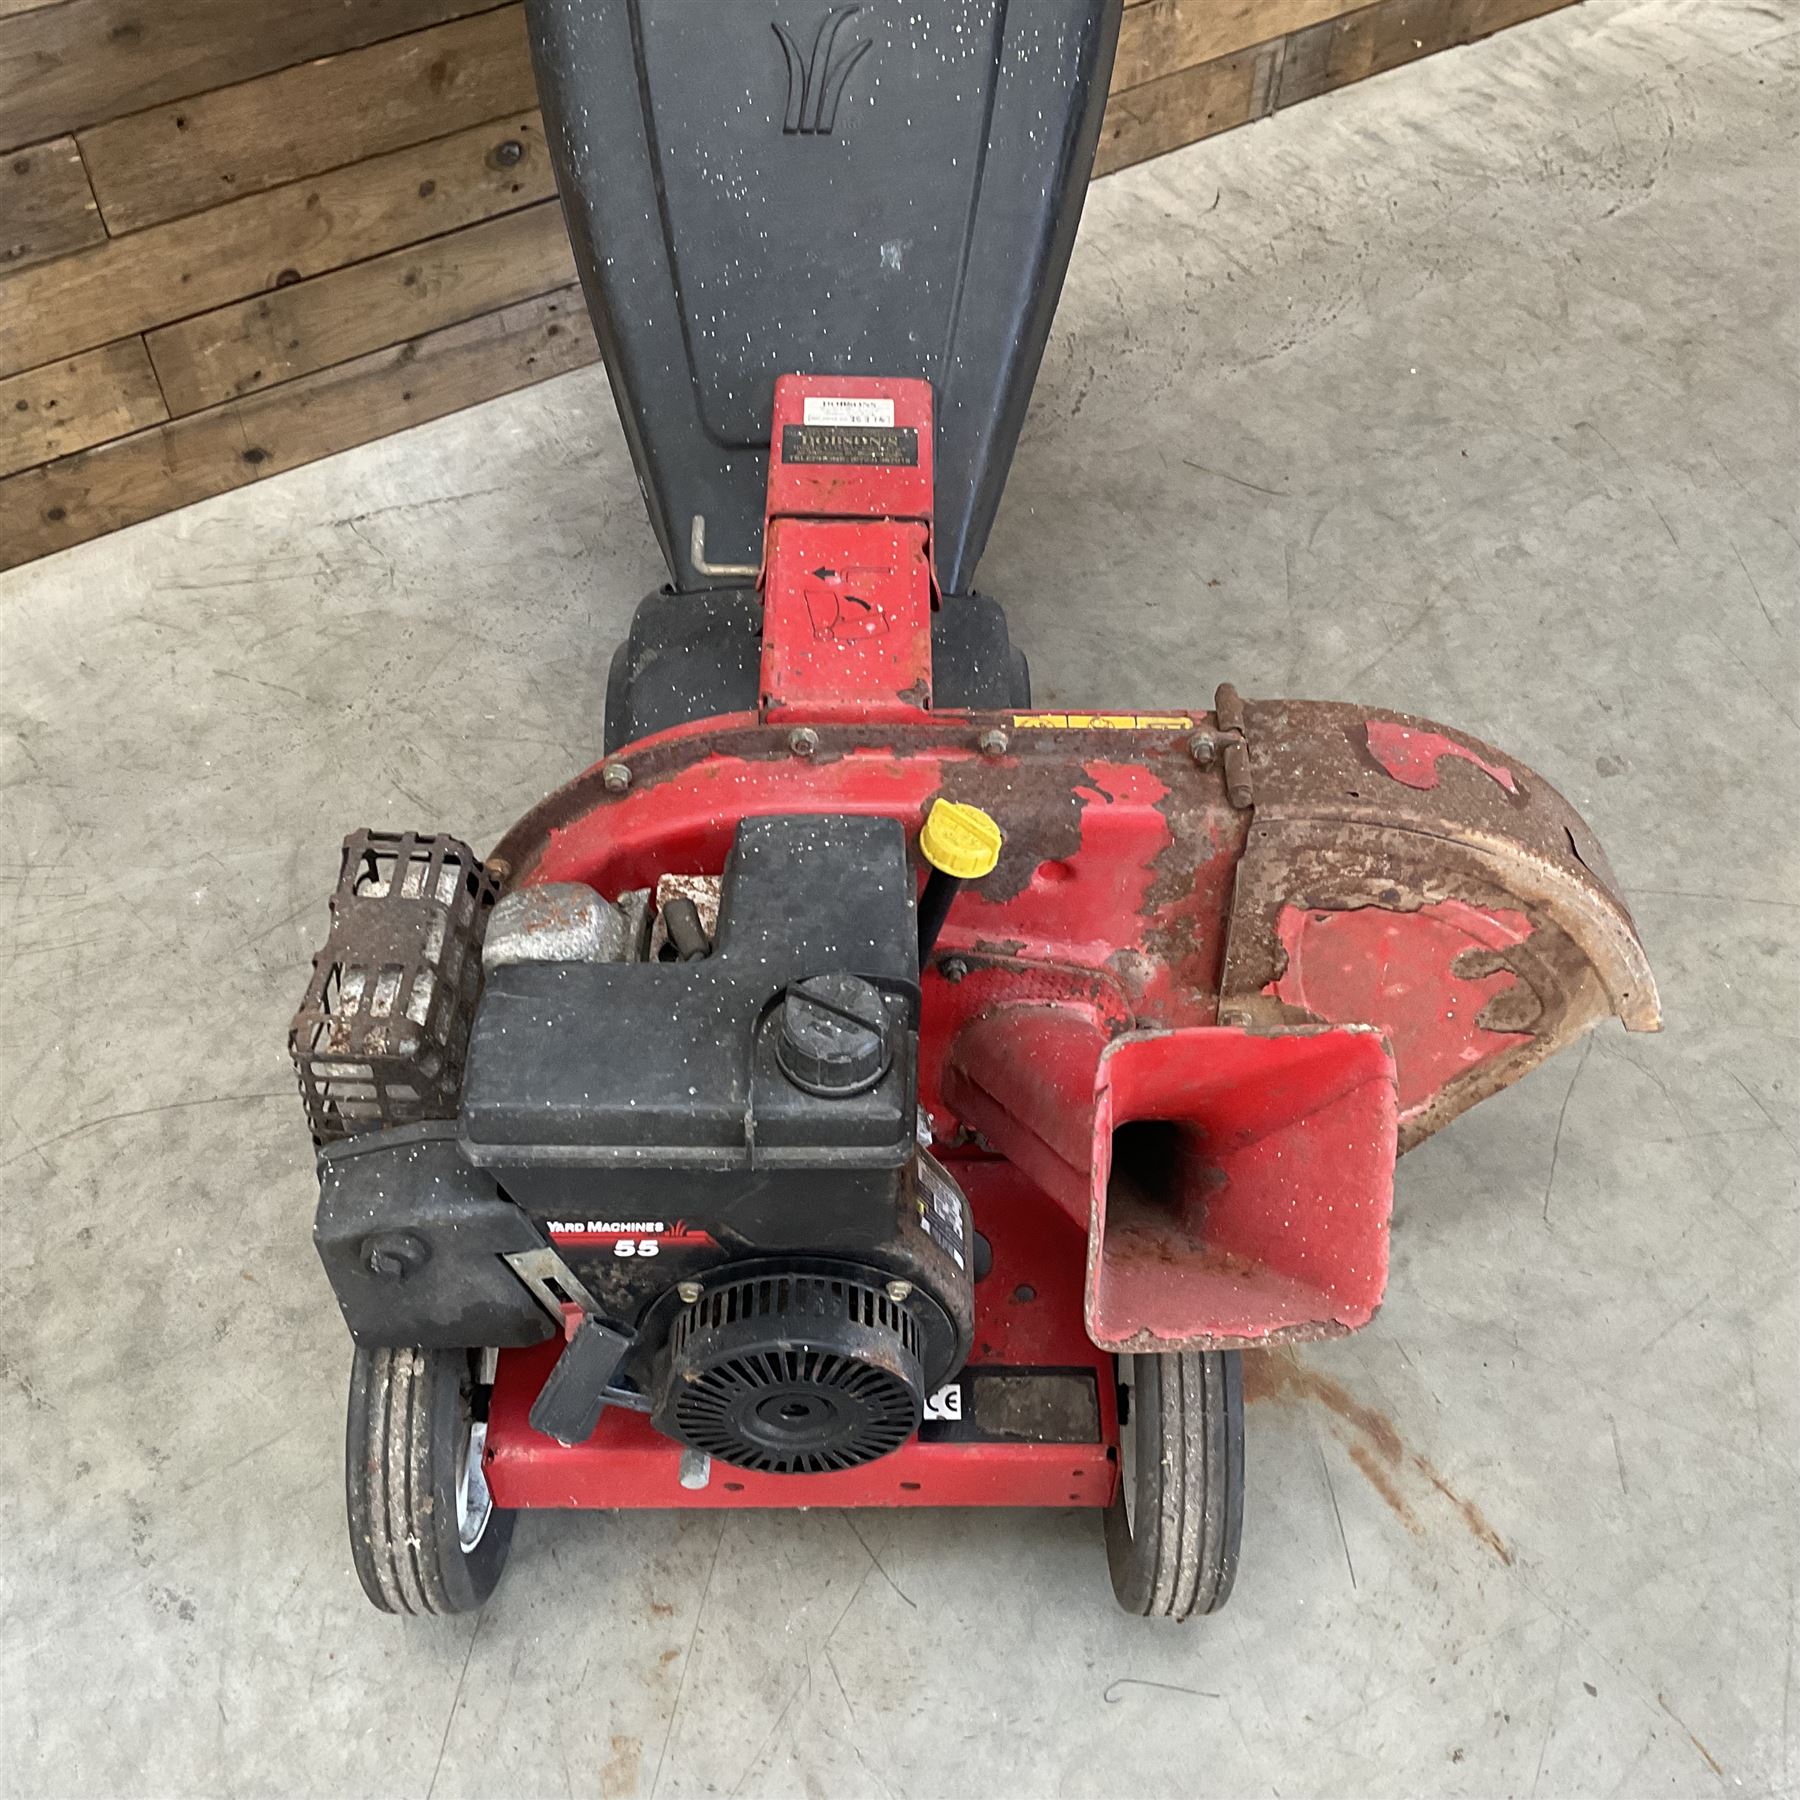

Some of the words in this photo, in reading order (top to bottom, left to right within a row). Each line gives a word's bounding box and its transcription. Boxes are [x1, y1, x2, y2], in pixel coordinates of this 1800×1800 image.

[546, 1221, 585, 1233] YARD
[587, 1221, 664, 1233] MACHINES
[613, 1239, 660, 1257] 55
[926, 1391, 958, 1412] CE
